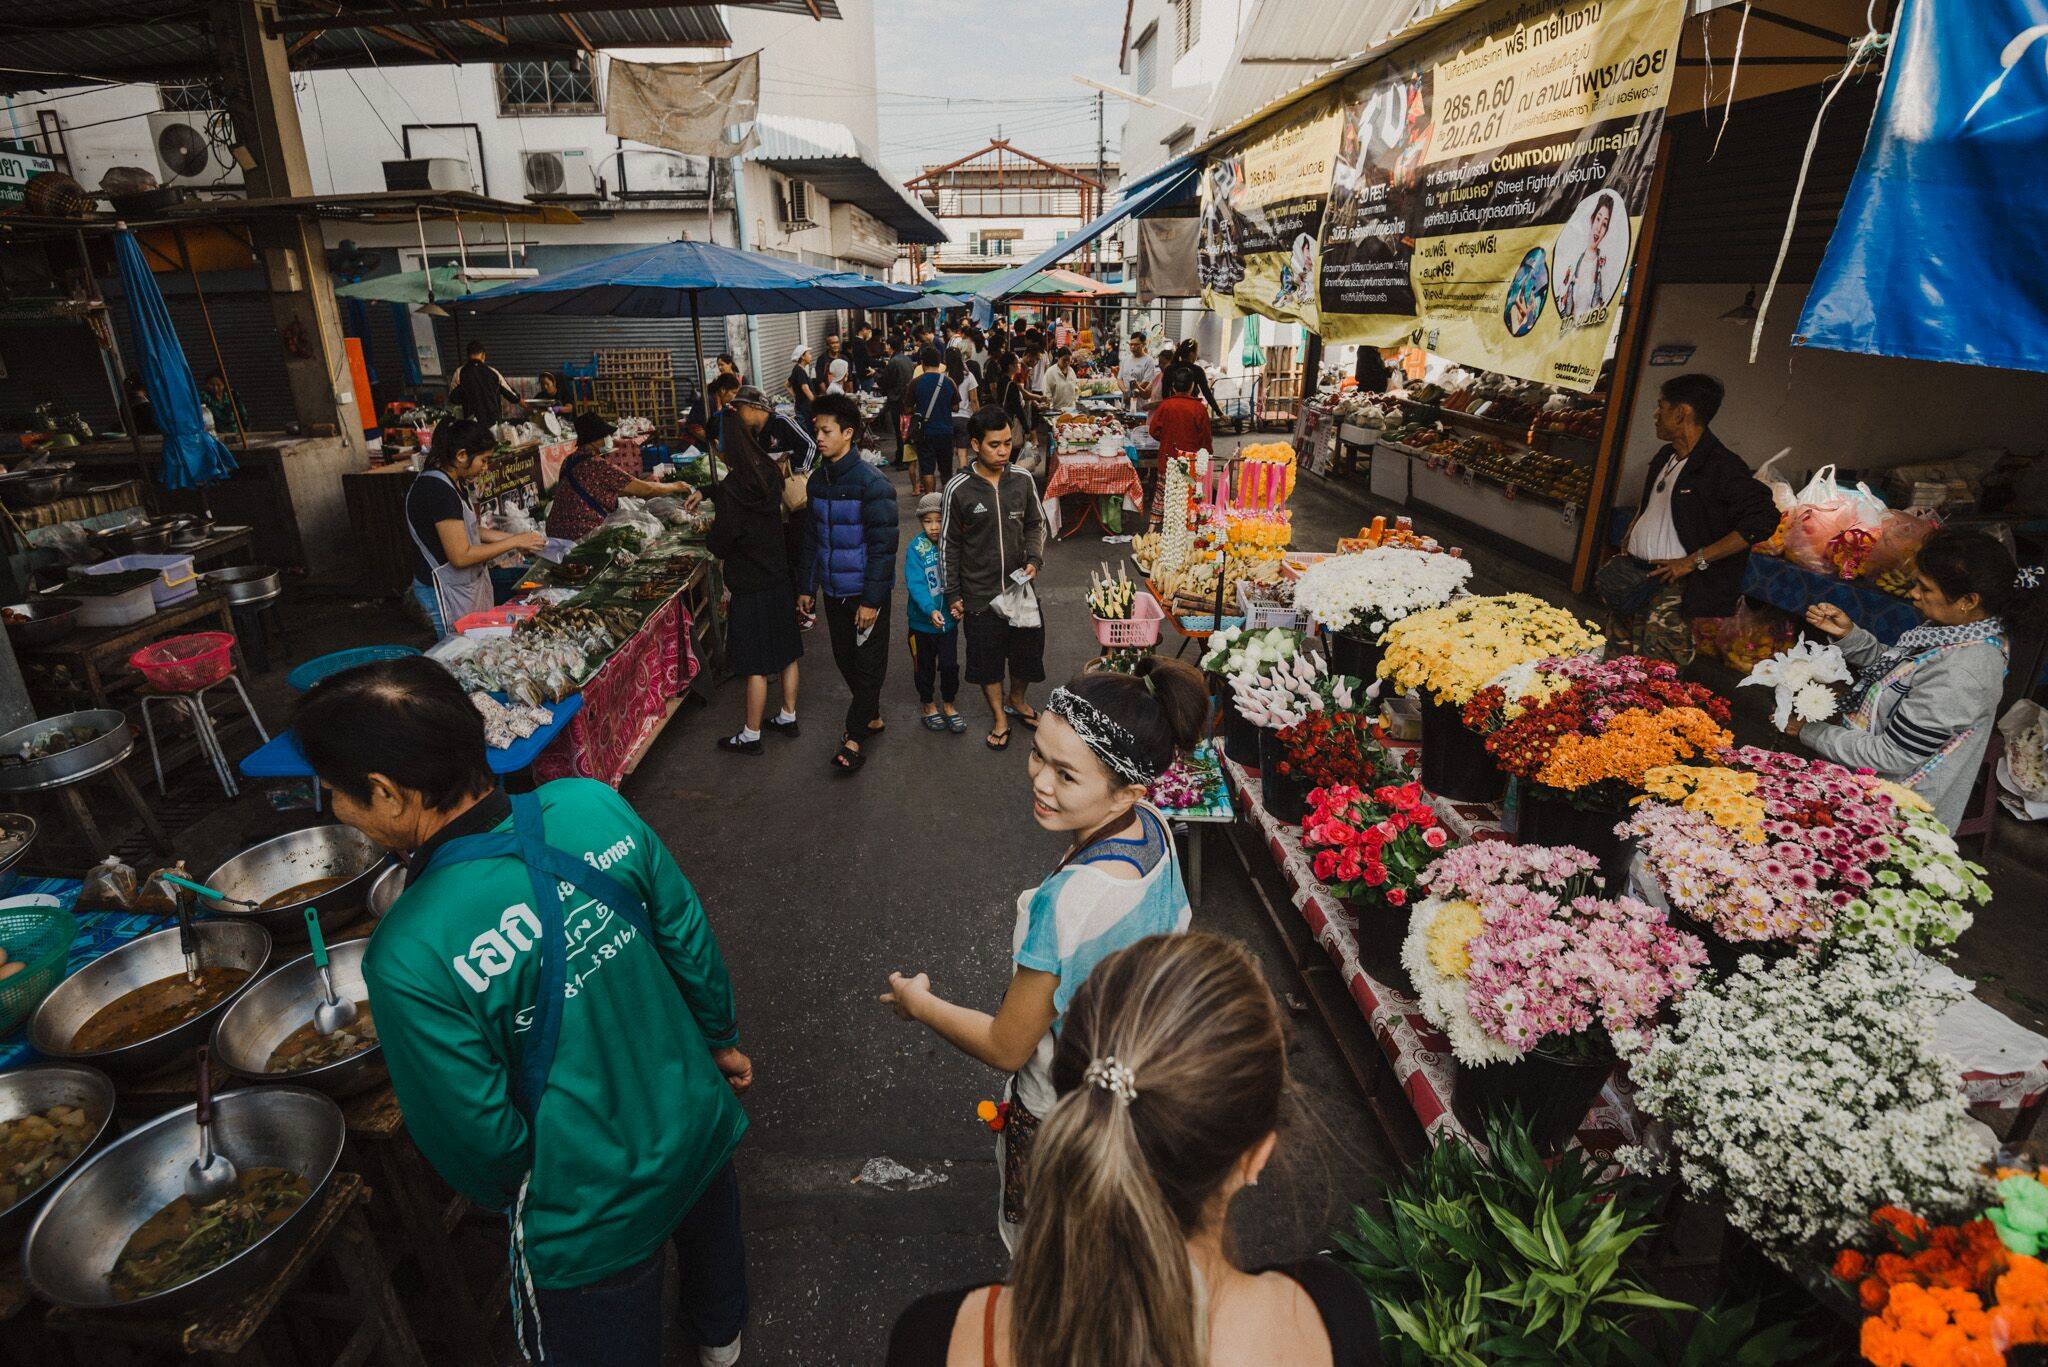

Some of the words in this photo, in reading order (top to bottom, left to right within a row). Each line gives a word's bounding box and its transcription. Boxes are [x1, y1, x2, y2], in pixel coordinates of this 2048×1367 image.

[1504, 29, 1528, 57] ฟรี!
[1533, 3, 1602, 47] ภายในงาน
[1492, 142, 1576, 173] COUNTDOWN
